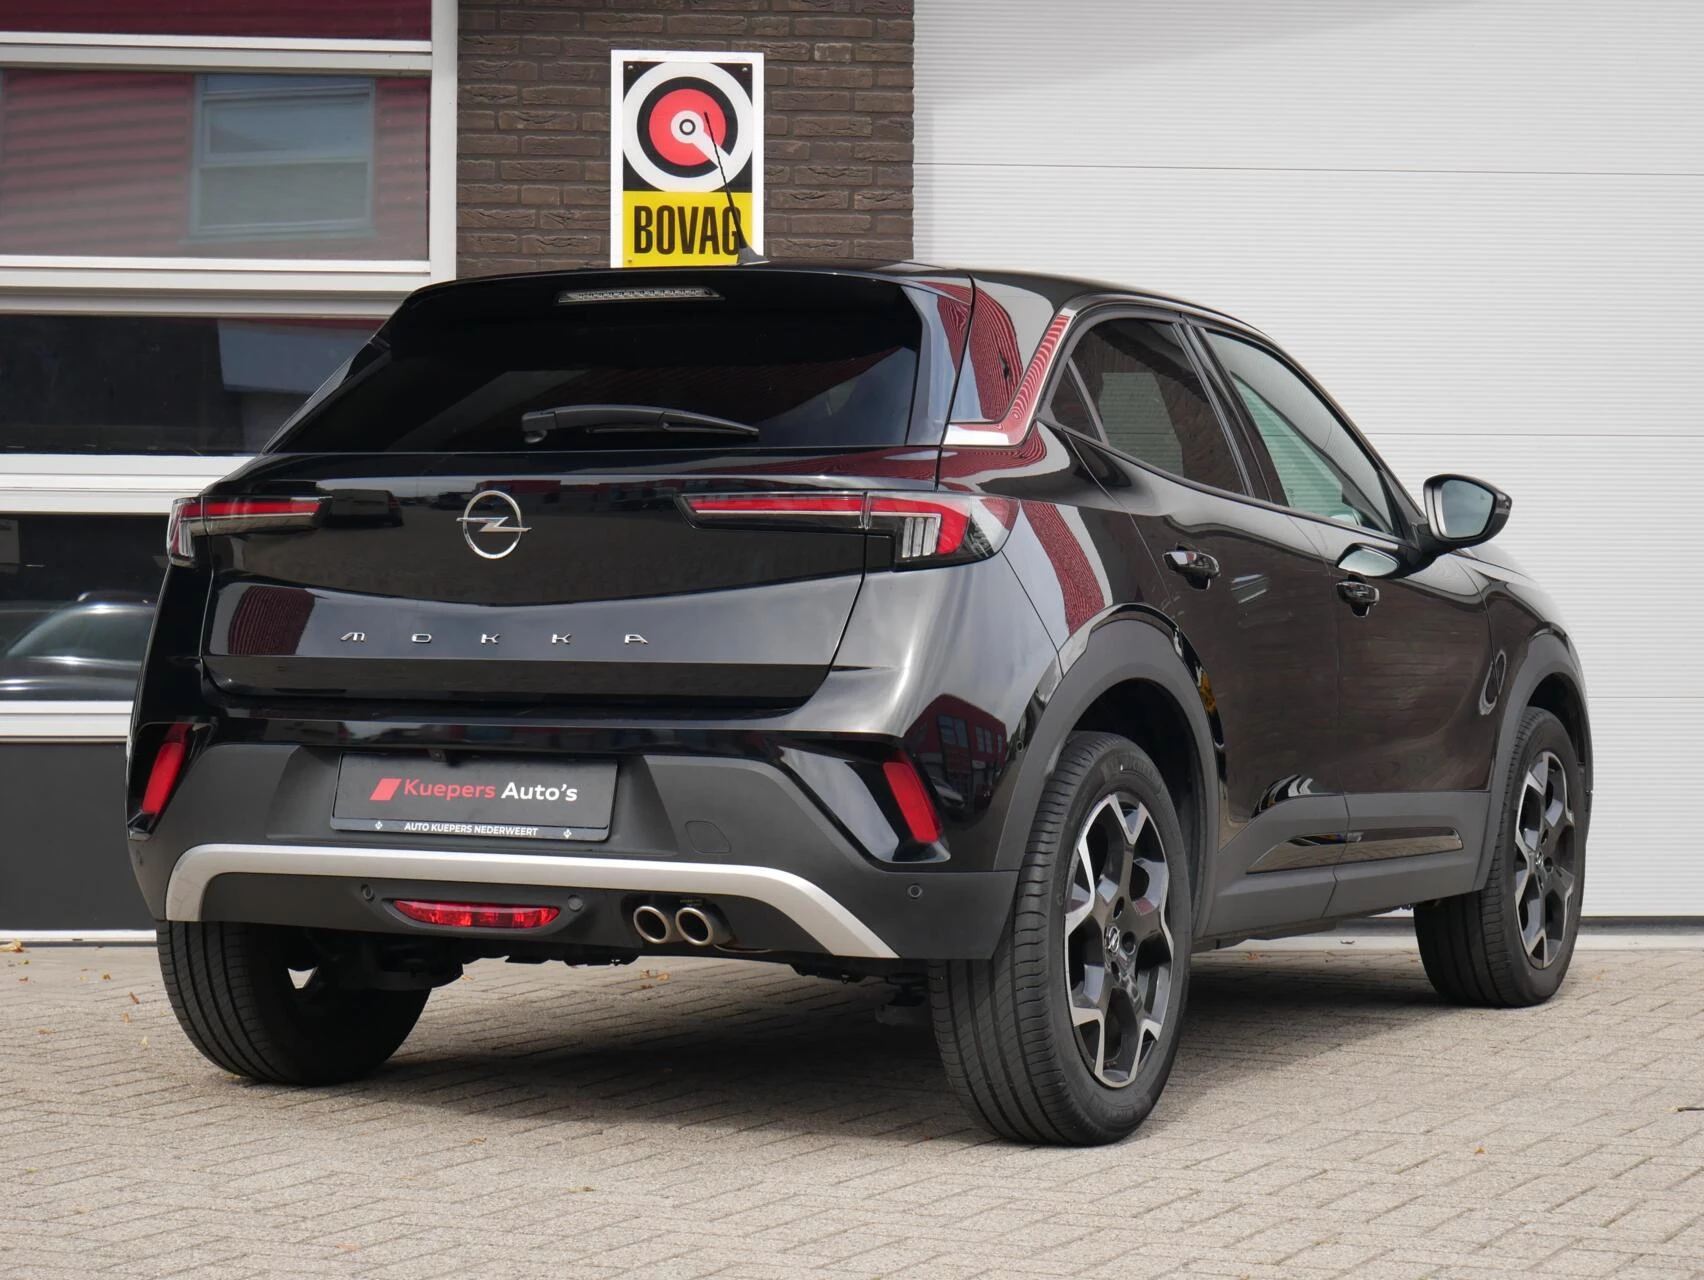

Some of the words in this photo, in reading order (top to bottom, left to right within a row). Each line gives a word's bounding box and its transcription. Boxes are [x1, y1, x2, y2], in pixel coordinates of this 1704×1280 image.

[634, 205, 741, 255] BOVAG
[403, 779, 496, 800] Kuepers
[501, 782, 578, 801] Auto's
[404, 822, 430, 832] AUTO
[430, 823, 473, 834] KUEPERS
[473, 825, 539, 836] NEDERWEERT
